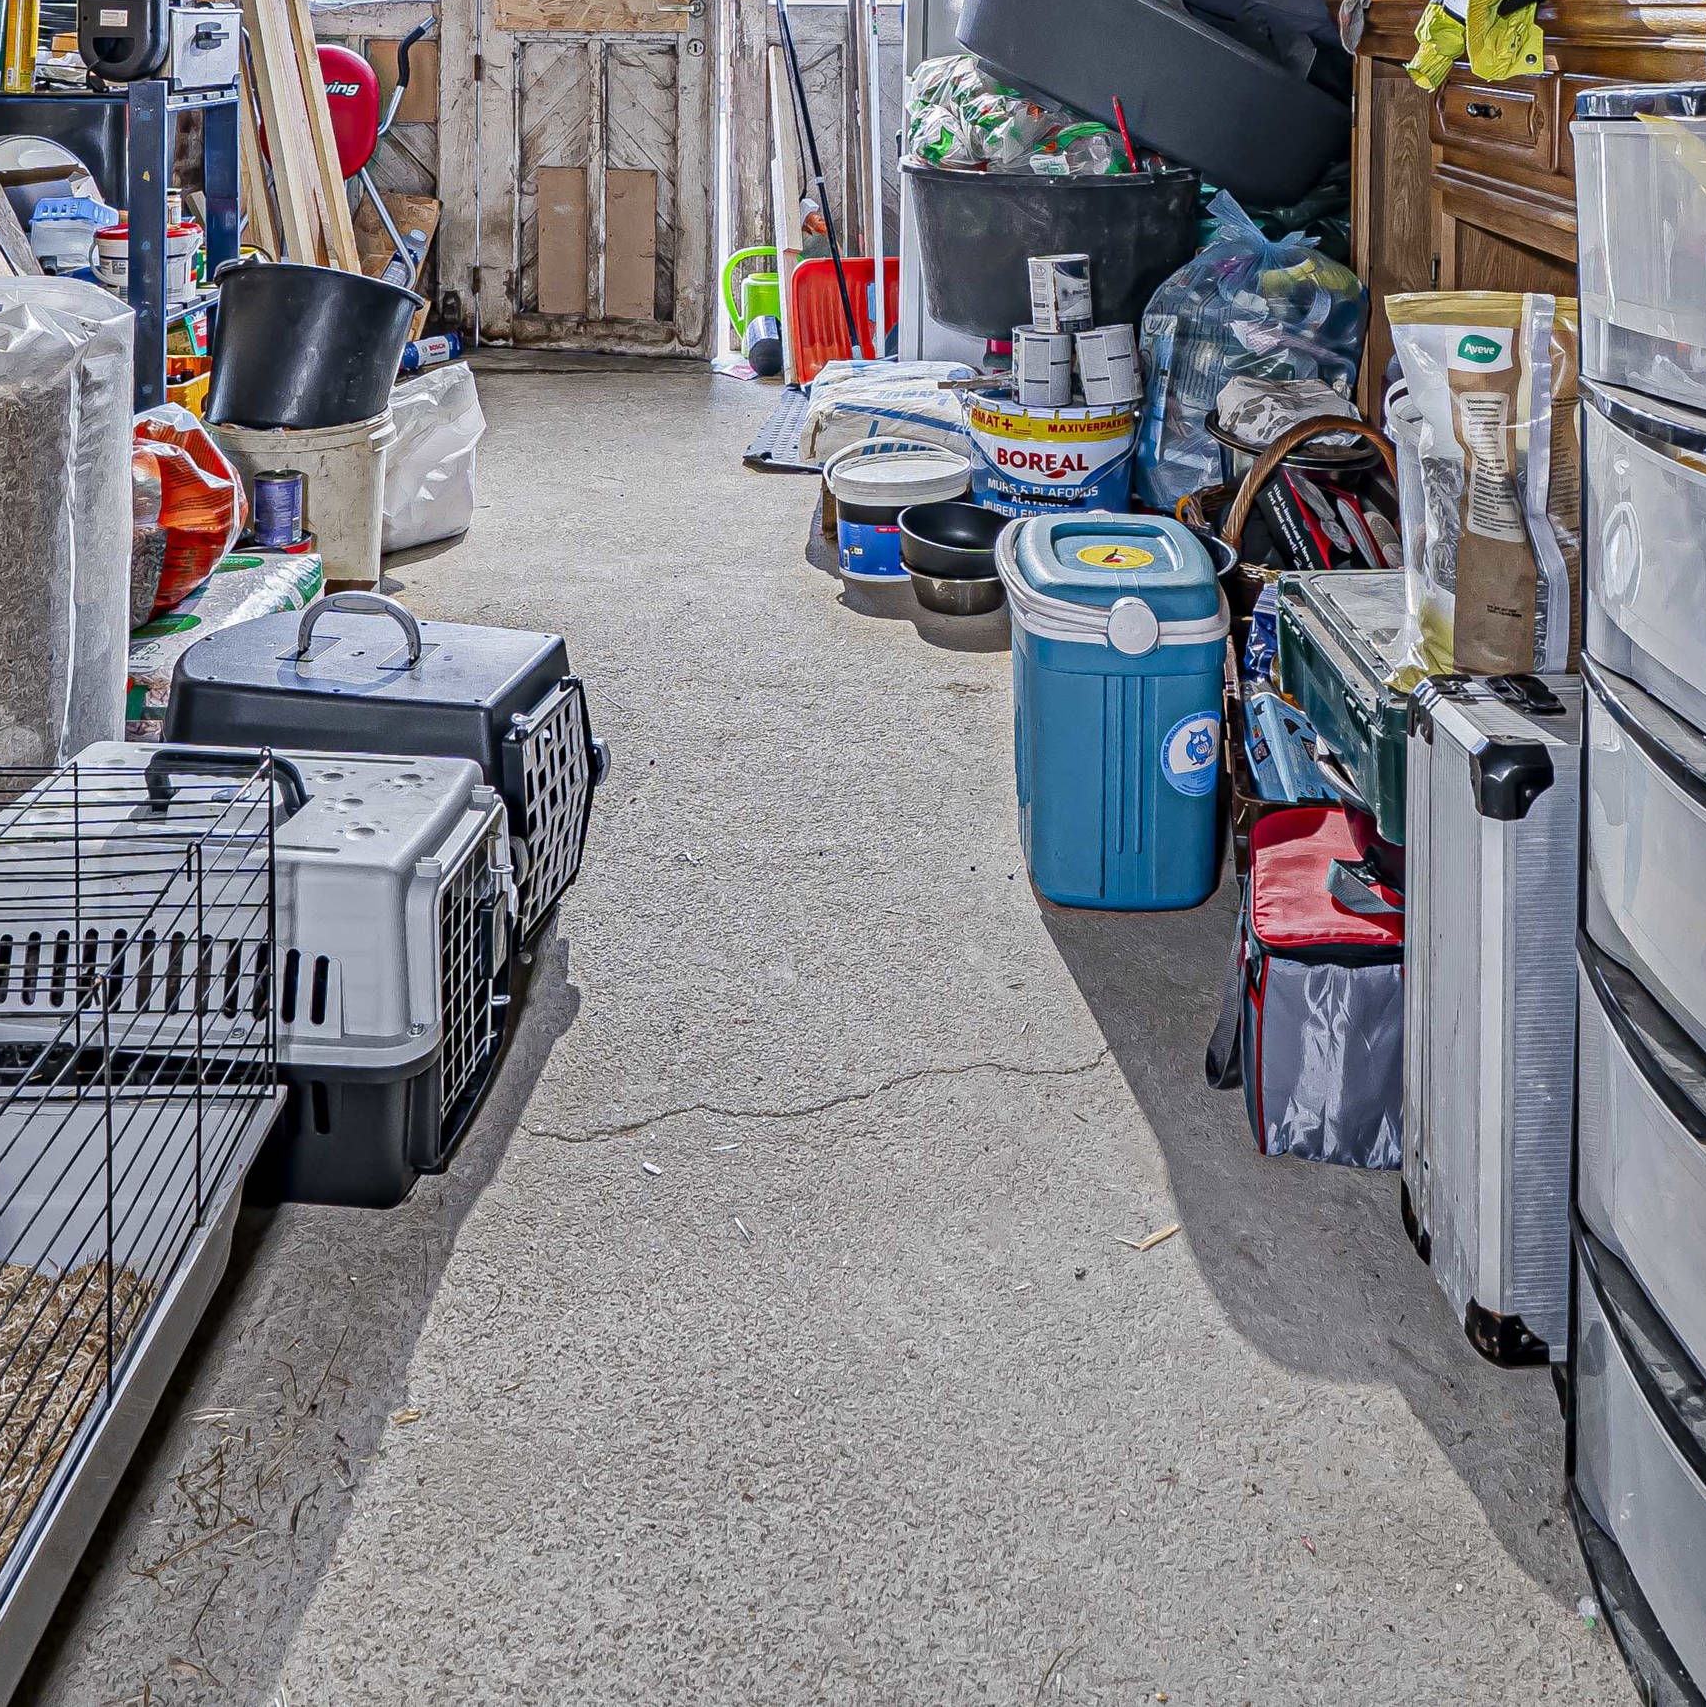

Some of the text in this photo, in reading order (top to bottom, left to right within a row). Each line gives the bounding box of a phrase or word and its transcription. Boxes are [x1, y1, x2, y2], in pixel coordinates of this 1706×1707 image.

[1464, 342, 1495, 355] Aveve
[996, 447, 1089, 474] BOREAL
[987, 477, 1016, 495] MURS
[983, 499, 1017, 518] MUREN
